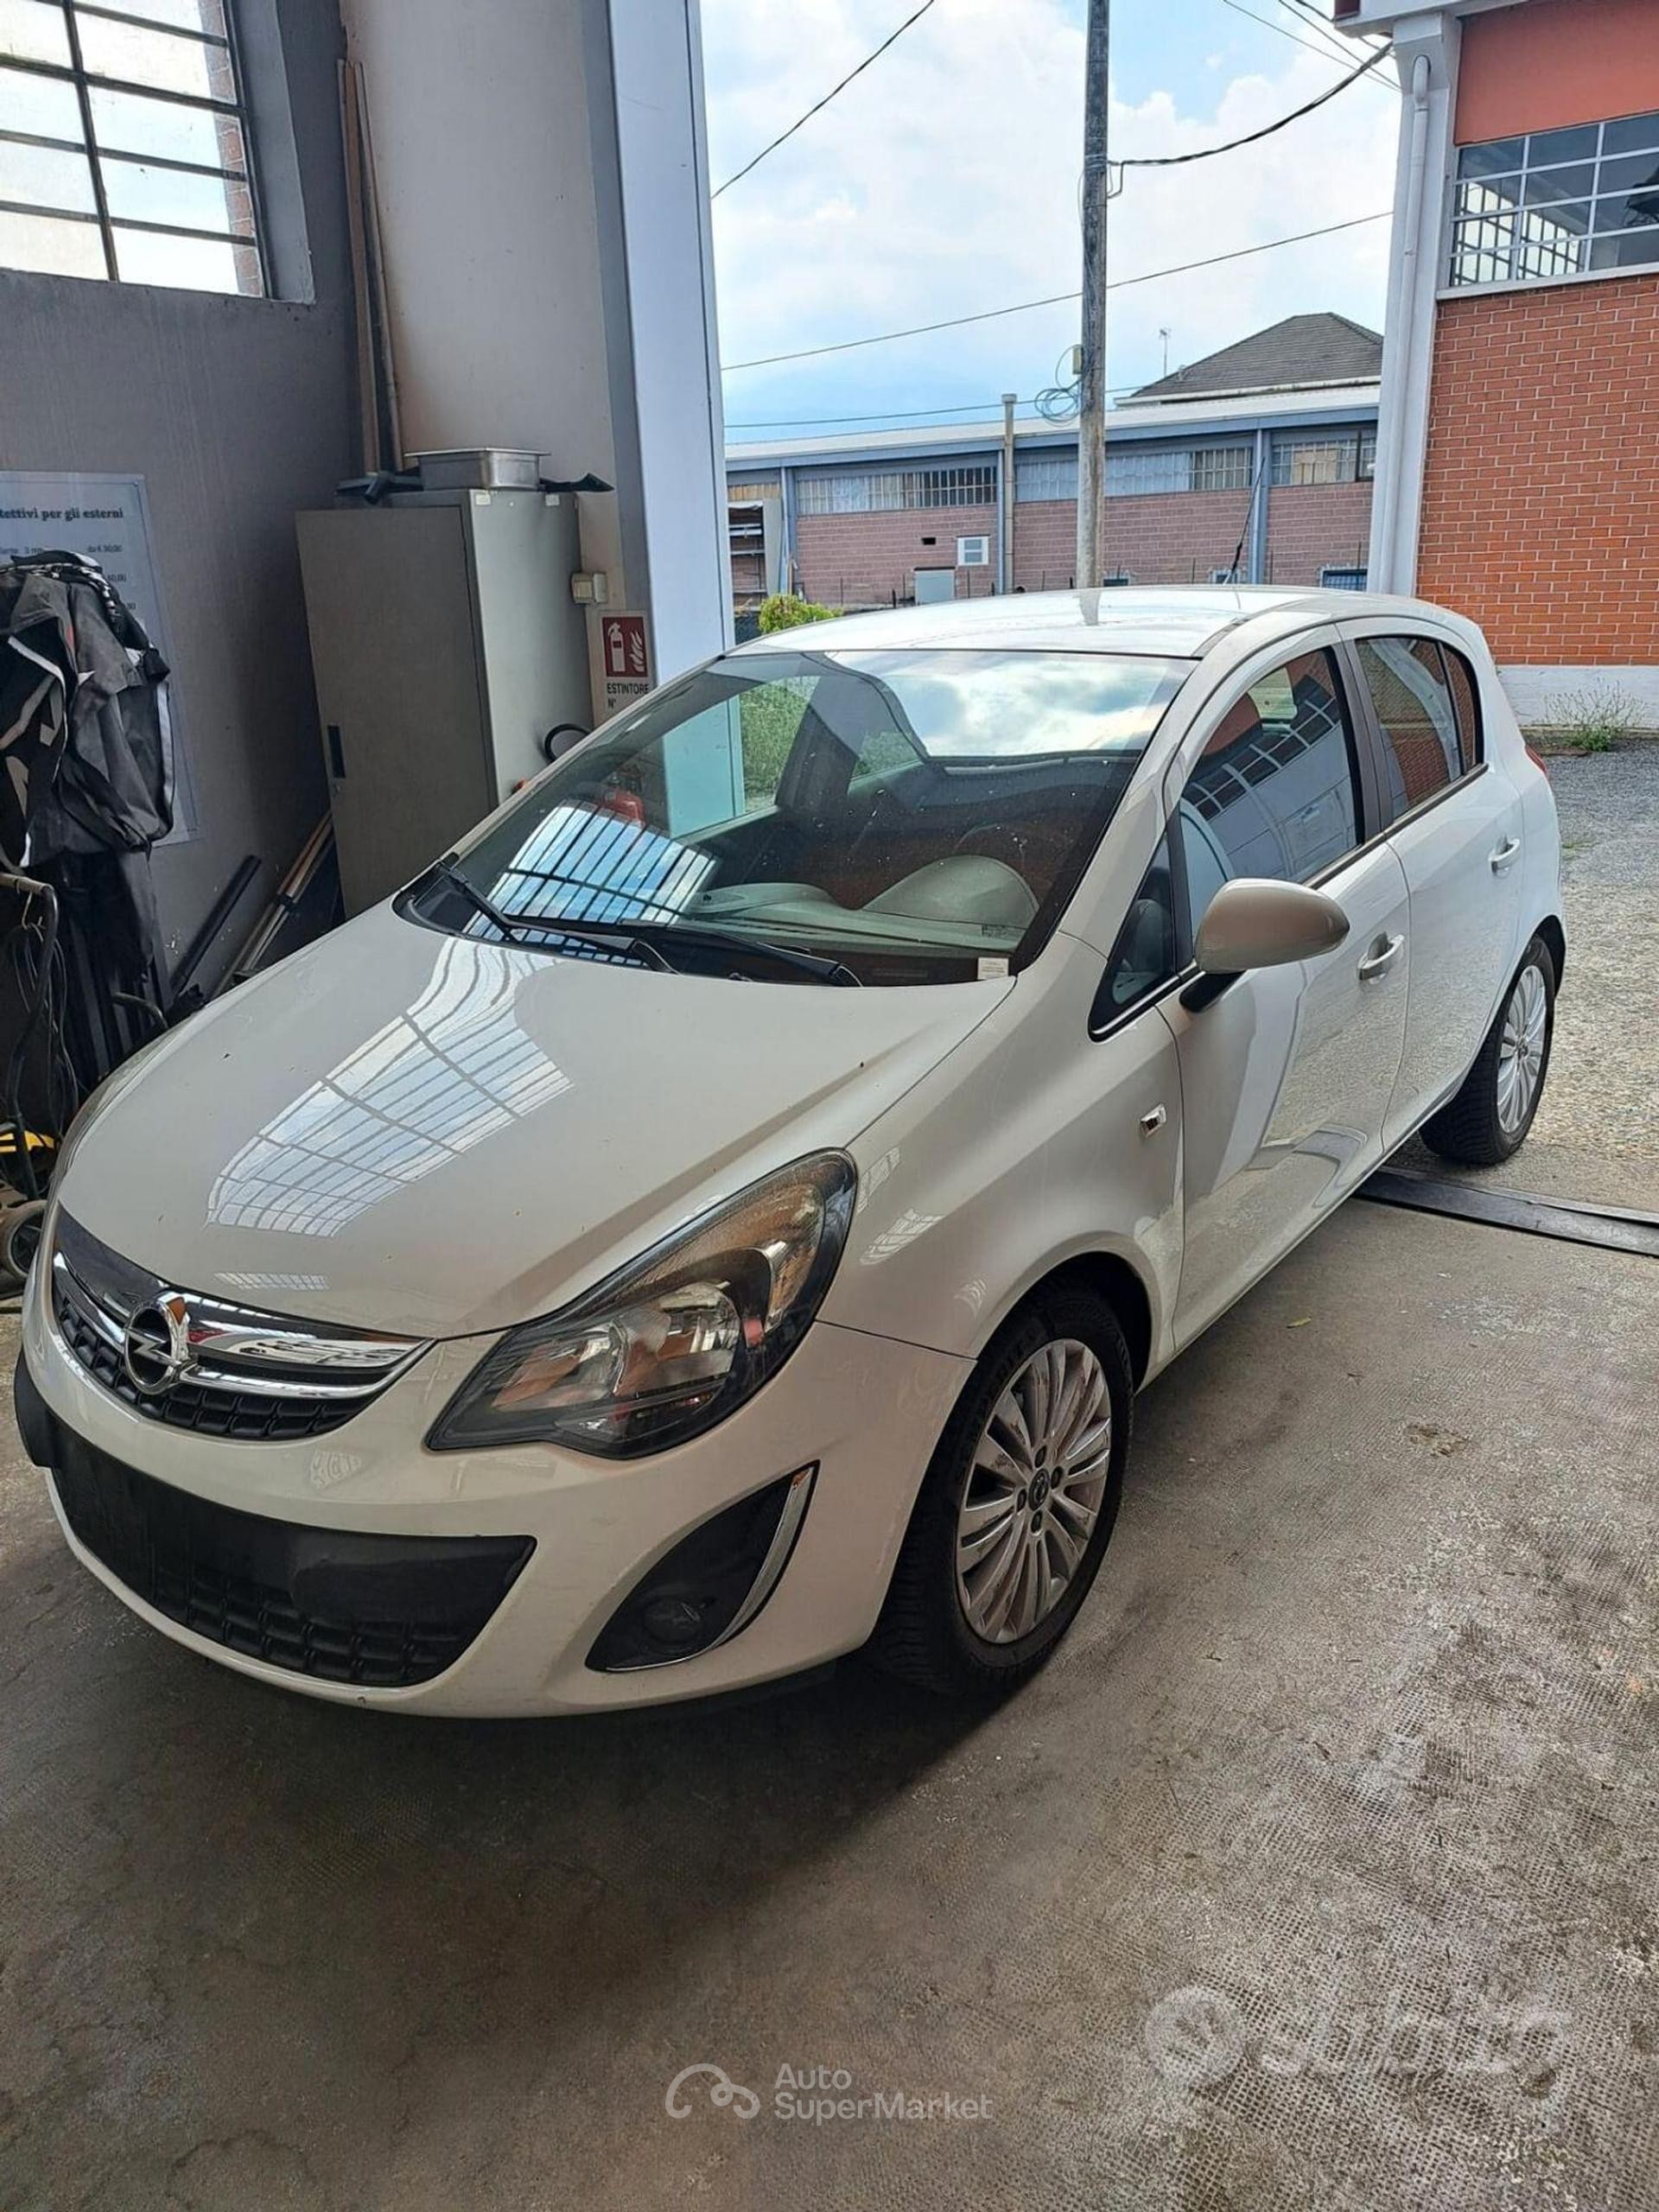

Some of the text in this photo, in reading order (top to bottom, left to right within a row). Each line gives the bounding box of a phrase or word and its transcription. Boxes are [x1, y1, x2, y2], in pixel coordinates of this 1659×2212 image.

[41, 511, 61, 522] per
[65, 507, 80, 522] gli
[83, 508, 124, 518] esterni
[607, 683, 649, 695] ESTINTORE
